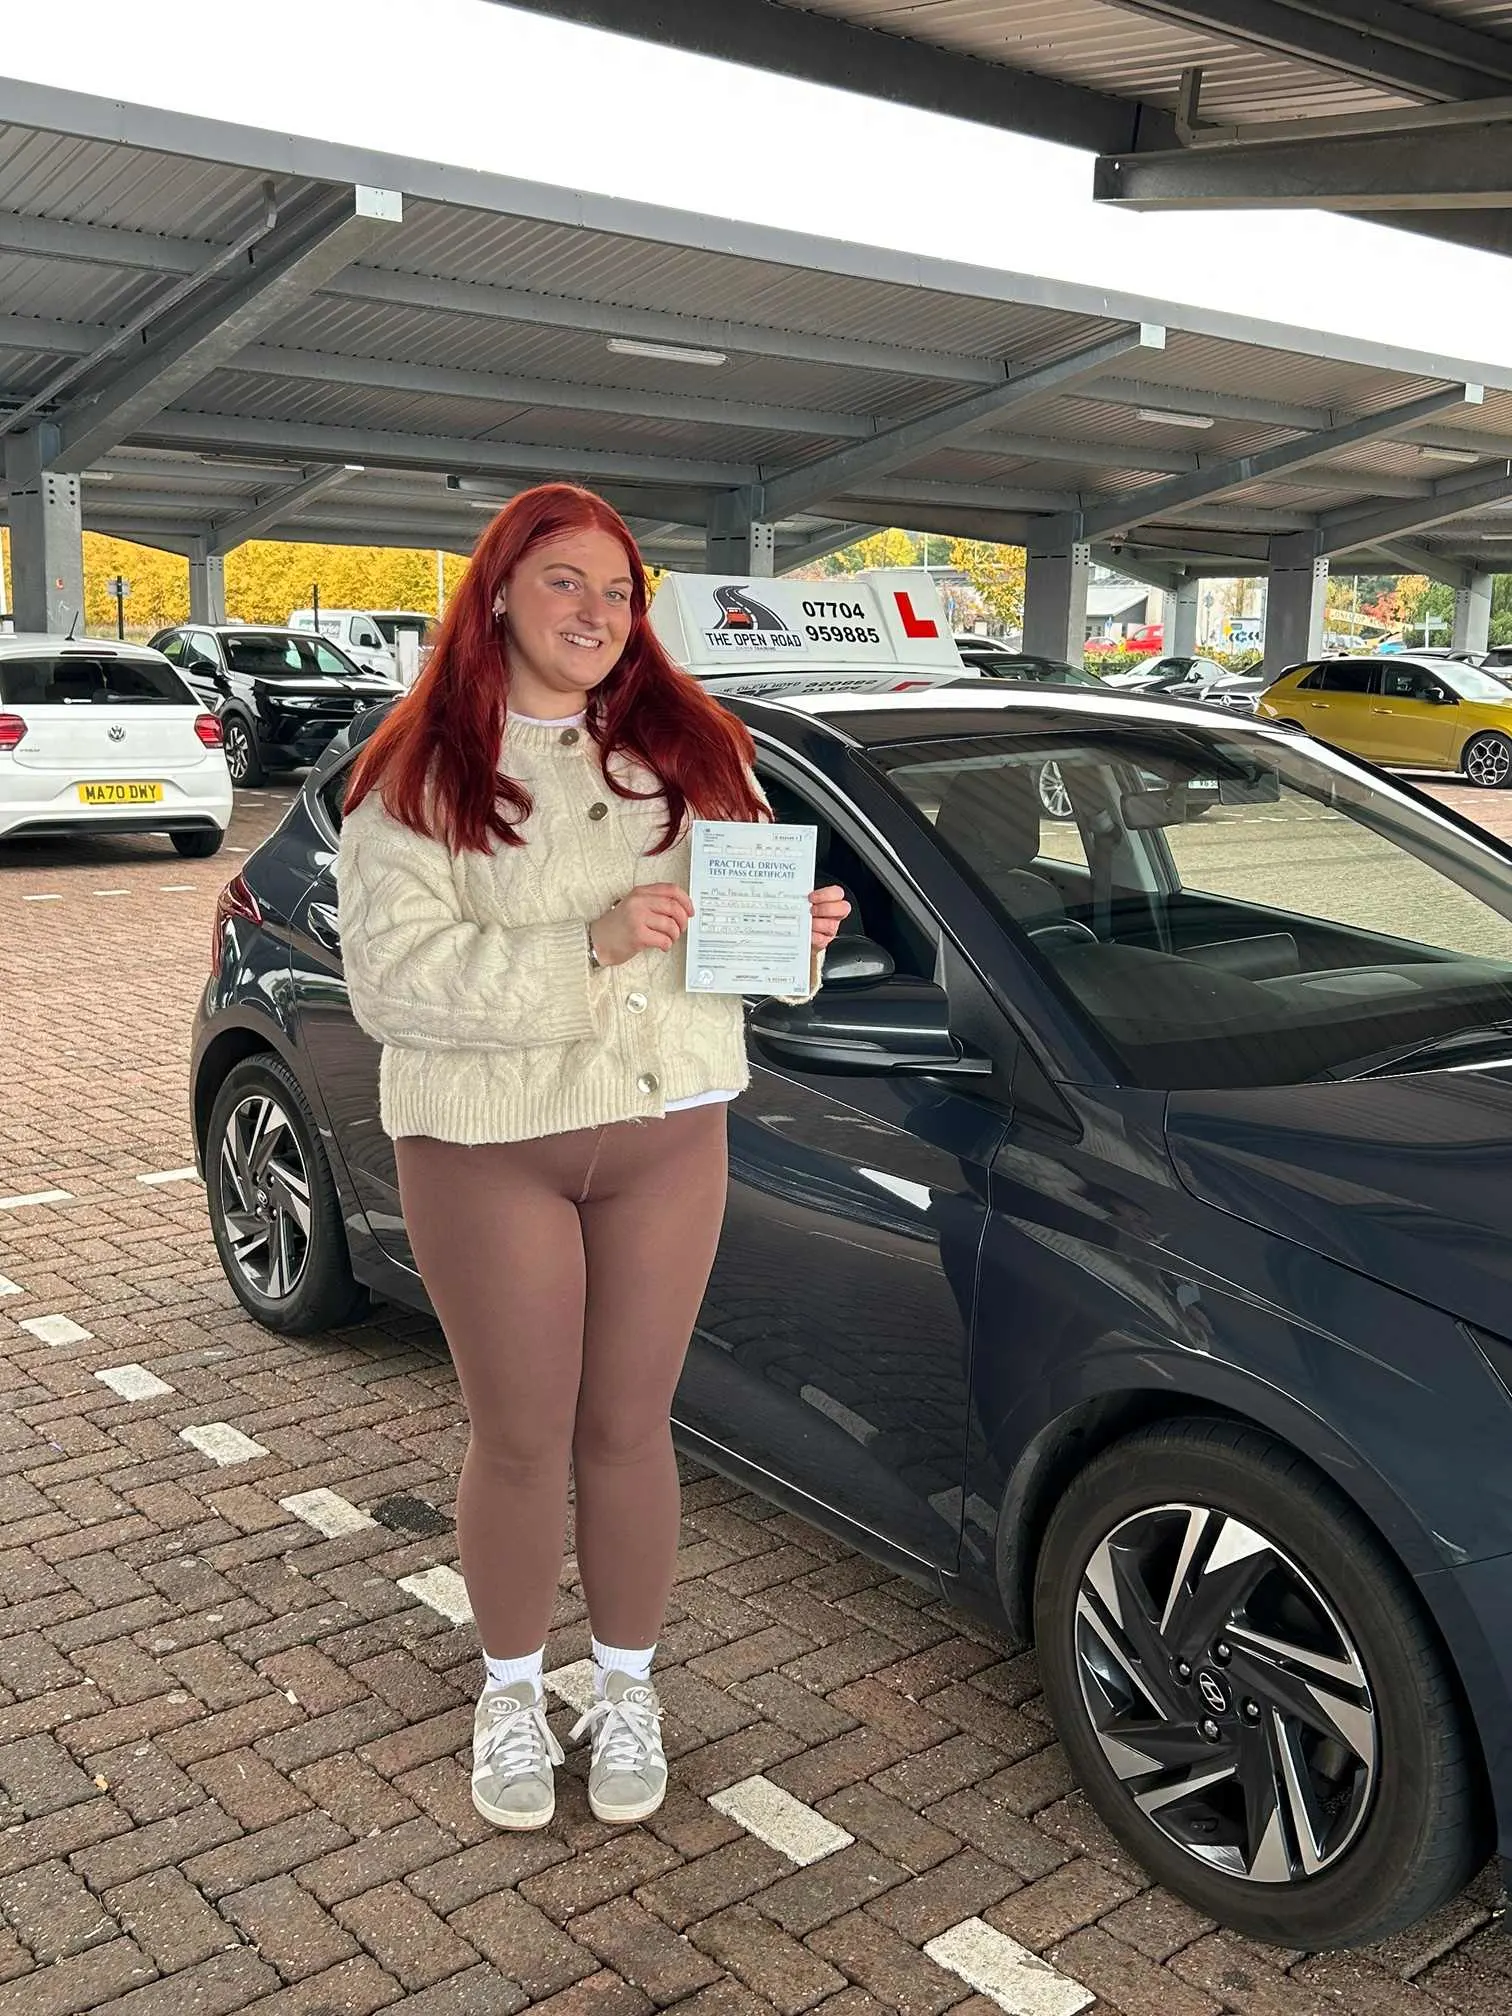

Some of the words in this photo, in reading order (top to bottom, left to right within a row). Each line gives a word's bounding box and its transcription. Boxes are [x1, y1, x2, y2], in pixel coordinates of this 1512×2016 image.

[802, 601, 865, 620] 07704
[893, 592, 939, 638] L
[705, 633, 730, 646] THE
[735, 633, 766, 647] OPEN
[772, 634, 802, 648] ROAD
[805, 625, 880, 643] 959885
[85, 785, 125, 800] MA70
[129, 785, 156, 799] DWY
[709, 859, 755, 869] PRACTICAL
[758, 861, 796, 870] DRIVING
[709, 868, 727, 876] TEST
[729, 869, 747, 877] PASS
[748, 870, 795, 879] CERTIFICATE
